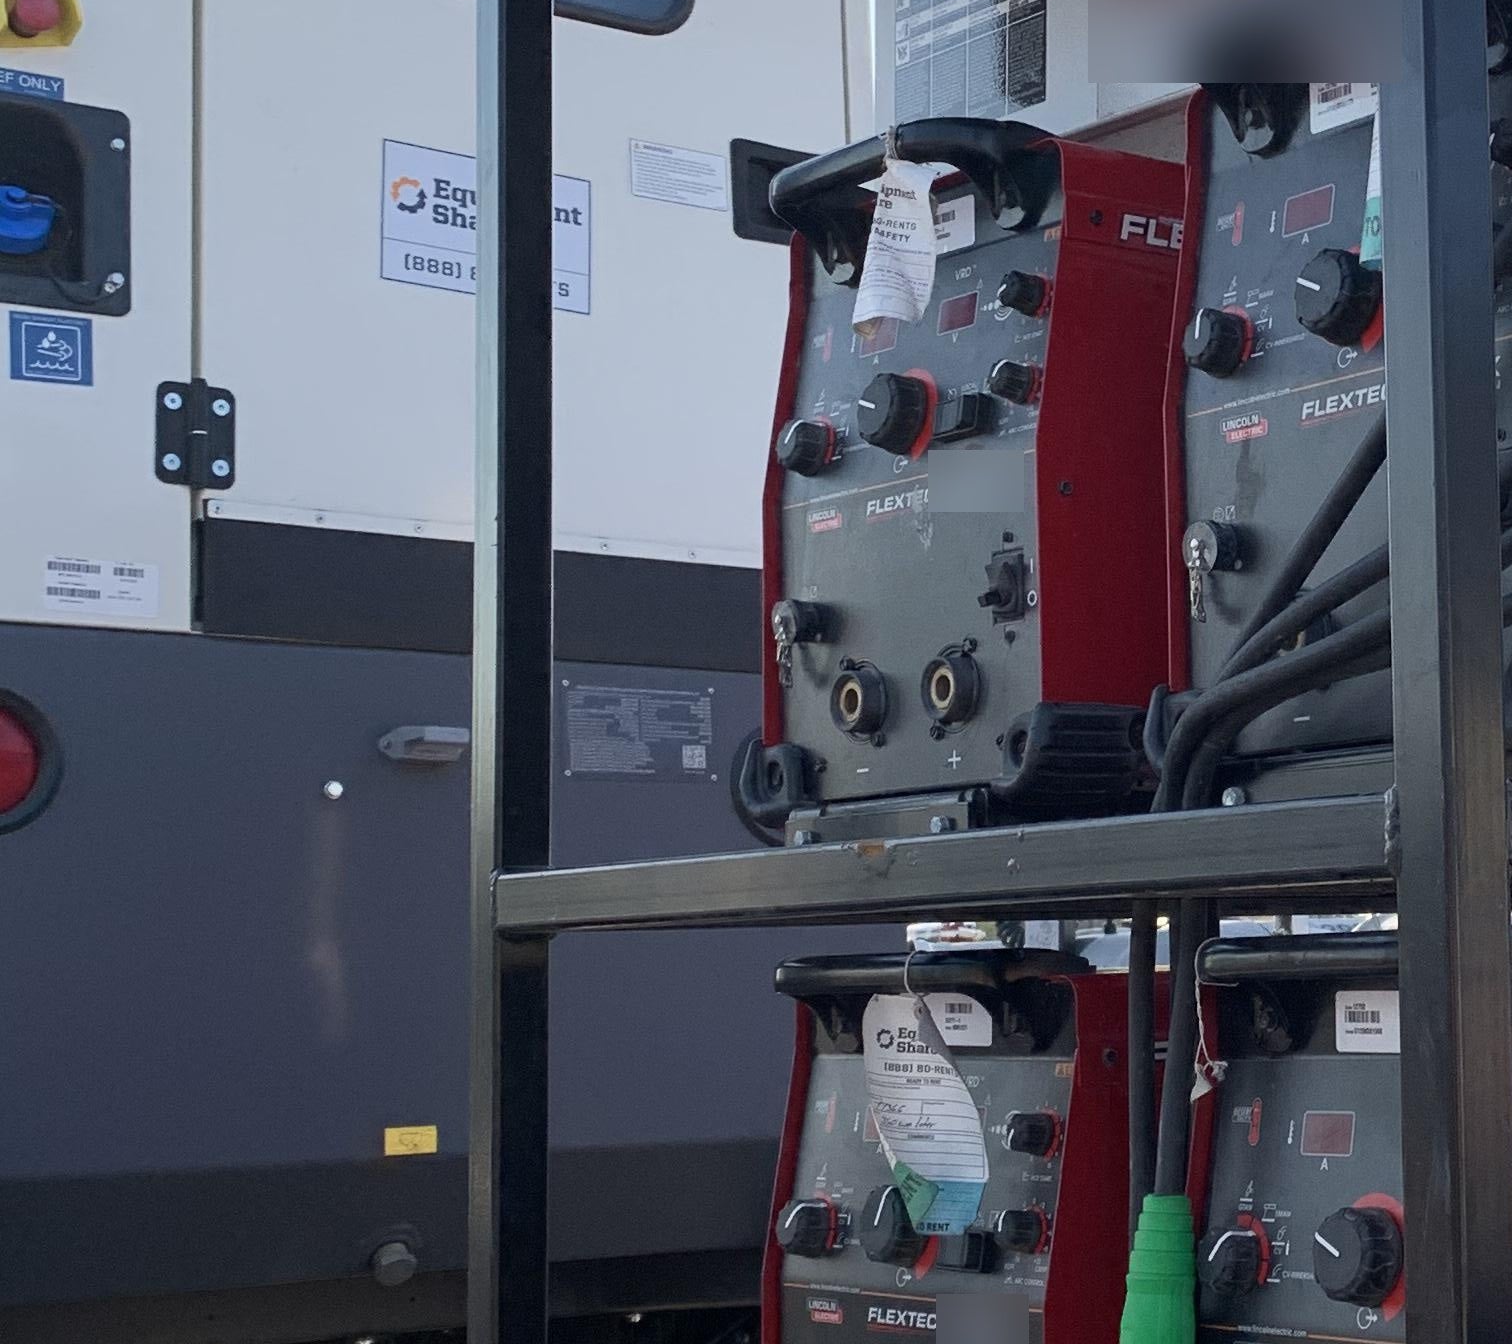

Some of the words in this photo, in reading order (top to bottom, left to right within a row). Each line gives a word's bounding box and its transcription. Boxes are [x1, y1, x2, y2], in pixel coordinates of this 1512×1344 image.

[18, 74, 61, 93] ONLY
[432, 204, 476, 230] Sha
[1222, 413, 1259, 432] LINCOLN
[1231, 426, 1264, 440] ELECTRIC
[808, 509, 835, 523] LINCOLN
[1320, 1158, 1329, 1171] A
[926, 1222, 950, 1232] RENT
[808, 1300, 837, 1311] LINCOLN
[867, 1307, 937, 1330] FLEXTEC
